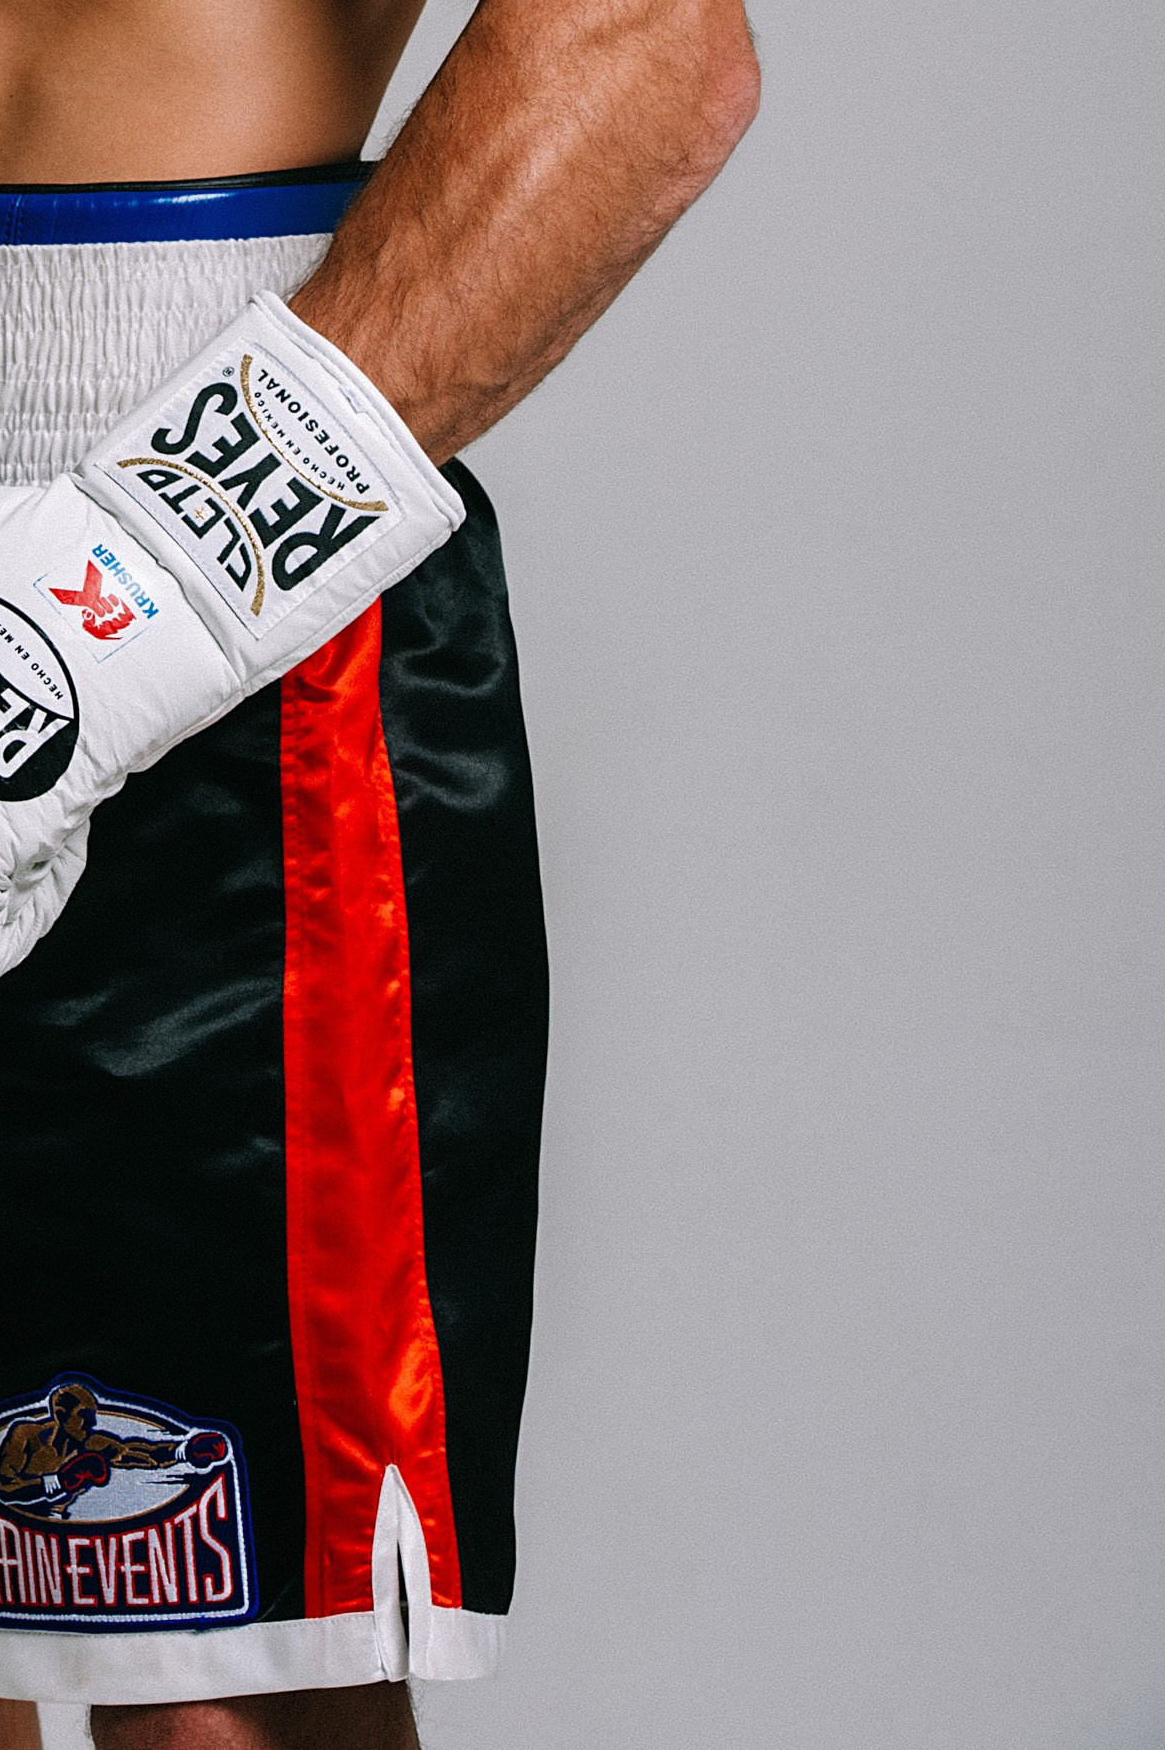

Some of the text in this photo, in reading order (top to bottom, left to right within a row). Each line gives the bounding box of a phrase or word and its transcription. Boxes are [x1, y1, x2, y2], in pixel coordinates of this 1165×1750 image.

[254, 391, 345, 491] HECHO EN MEXICO
[258, 369, 370, 494] PROFESIONAL
[136, 469, 252, 592] CLETO
[150, 382, 381, 592] REYES
[92, 543, 159, 619] KRUSHER
[14, 644, 30, 660] EN
[30, 662, 64, 700] HECHO
